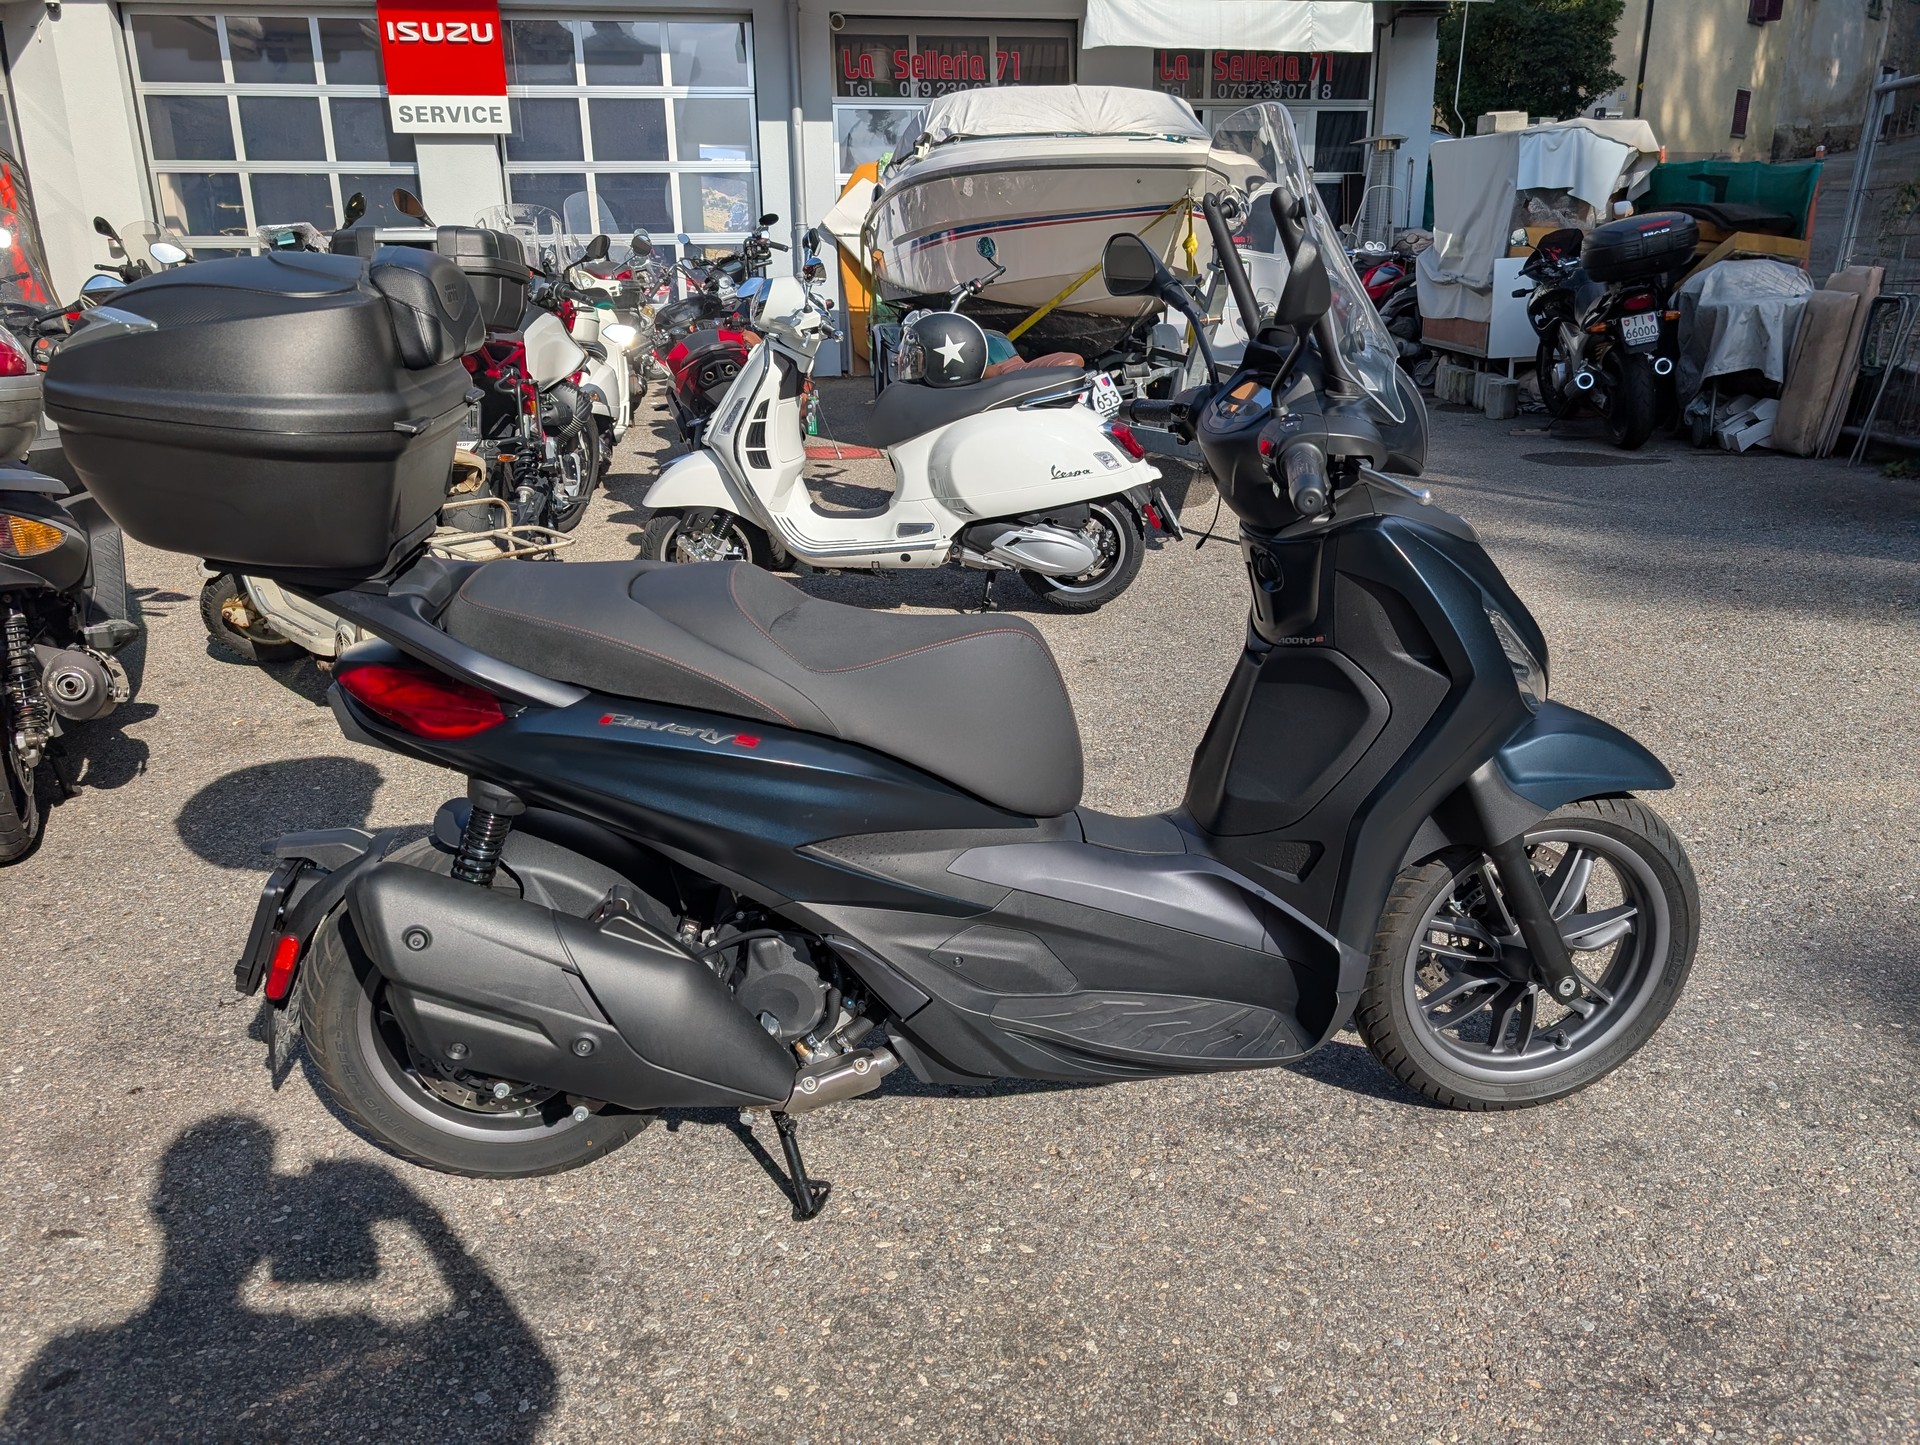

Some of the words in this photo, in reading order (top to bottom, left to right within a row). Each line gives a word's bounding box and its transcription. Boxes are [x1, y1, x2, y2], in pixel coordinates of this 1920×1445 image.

[386, 21, 493, 43] ISUZU
[843, 49, 875, 80] La
[893, 50, 986, 81] Selleria
[995, 51, 1021, 81] 71
[1160, 50, 1190, 81] La
[1214, 51, 1300, 81] Selleria
[1309, 52, 1334, 82] 71
[845, 81, 879, 97] Tel.
[900, 81, 932, 97] 079
[1217, 83, 1248, 99] 079
[1252, 84, 1283, 99] 230
[1286, 84, 1308, 99] 07
[398, 105, 503, 124] SERVICE
[1631, 315, 1645, 327] TI
[1625, 324, 1657, 339] 66000
[1096, 390, 1120, 410] 653
[1050, 464, 1093, 480] Vespa
[599, 712, 737, 745] Beverly
